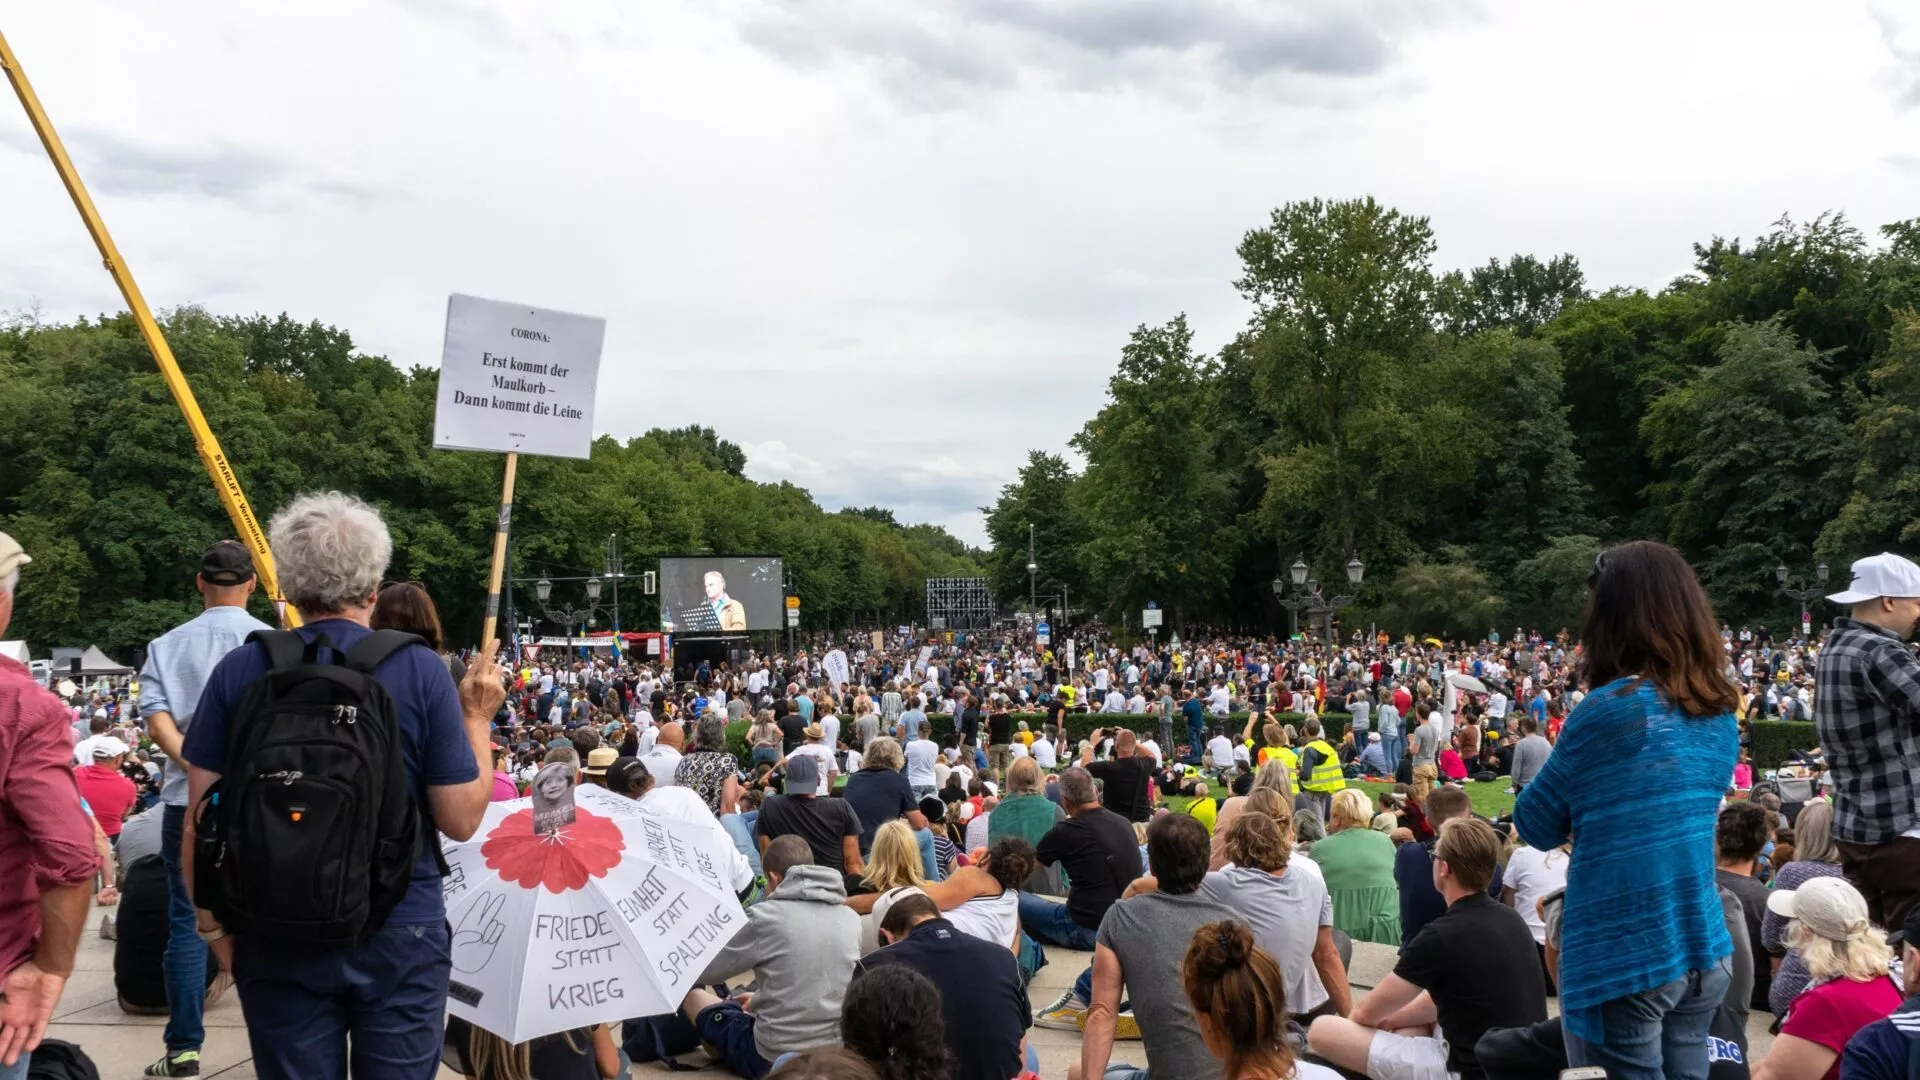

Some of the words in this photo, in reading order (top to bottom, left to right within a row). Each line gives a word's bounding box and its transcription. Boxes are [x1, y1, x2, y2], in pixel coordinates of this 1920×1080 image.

[511, 327, 550, 343] CORONA:
[482, 352, 508, 369] Erst
[510, 357, 547, 375] kommt
[550, 364, 569, 378] der
[492, 374, 546, 394] Maulkorb
[454, 390, 488, 407] Dann
[492, 395, 530, 412] kommt
[533, 401, 550, 415] die
[552, 403, 583, 419] Leine
[214, 454, 240, 499] STARLIFT
[238, 502, 267, 555] Vermietung
[667, 829, 694, 873] STATT
[616, 865, 668, 924] EINHEIT
[536, 911, 613, 942] FRIEDE
[653, 891, 690, 936] STATT
[551, 942, 622, 970] STATT
[659, 904, 732, 986] SPALTUNG
[548, 977, 624, 1010] KRIEG
